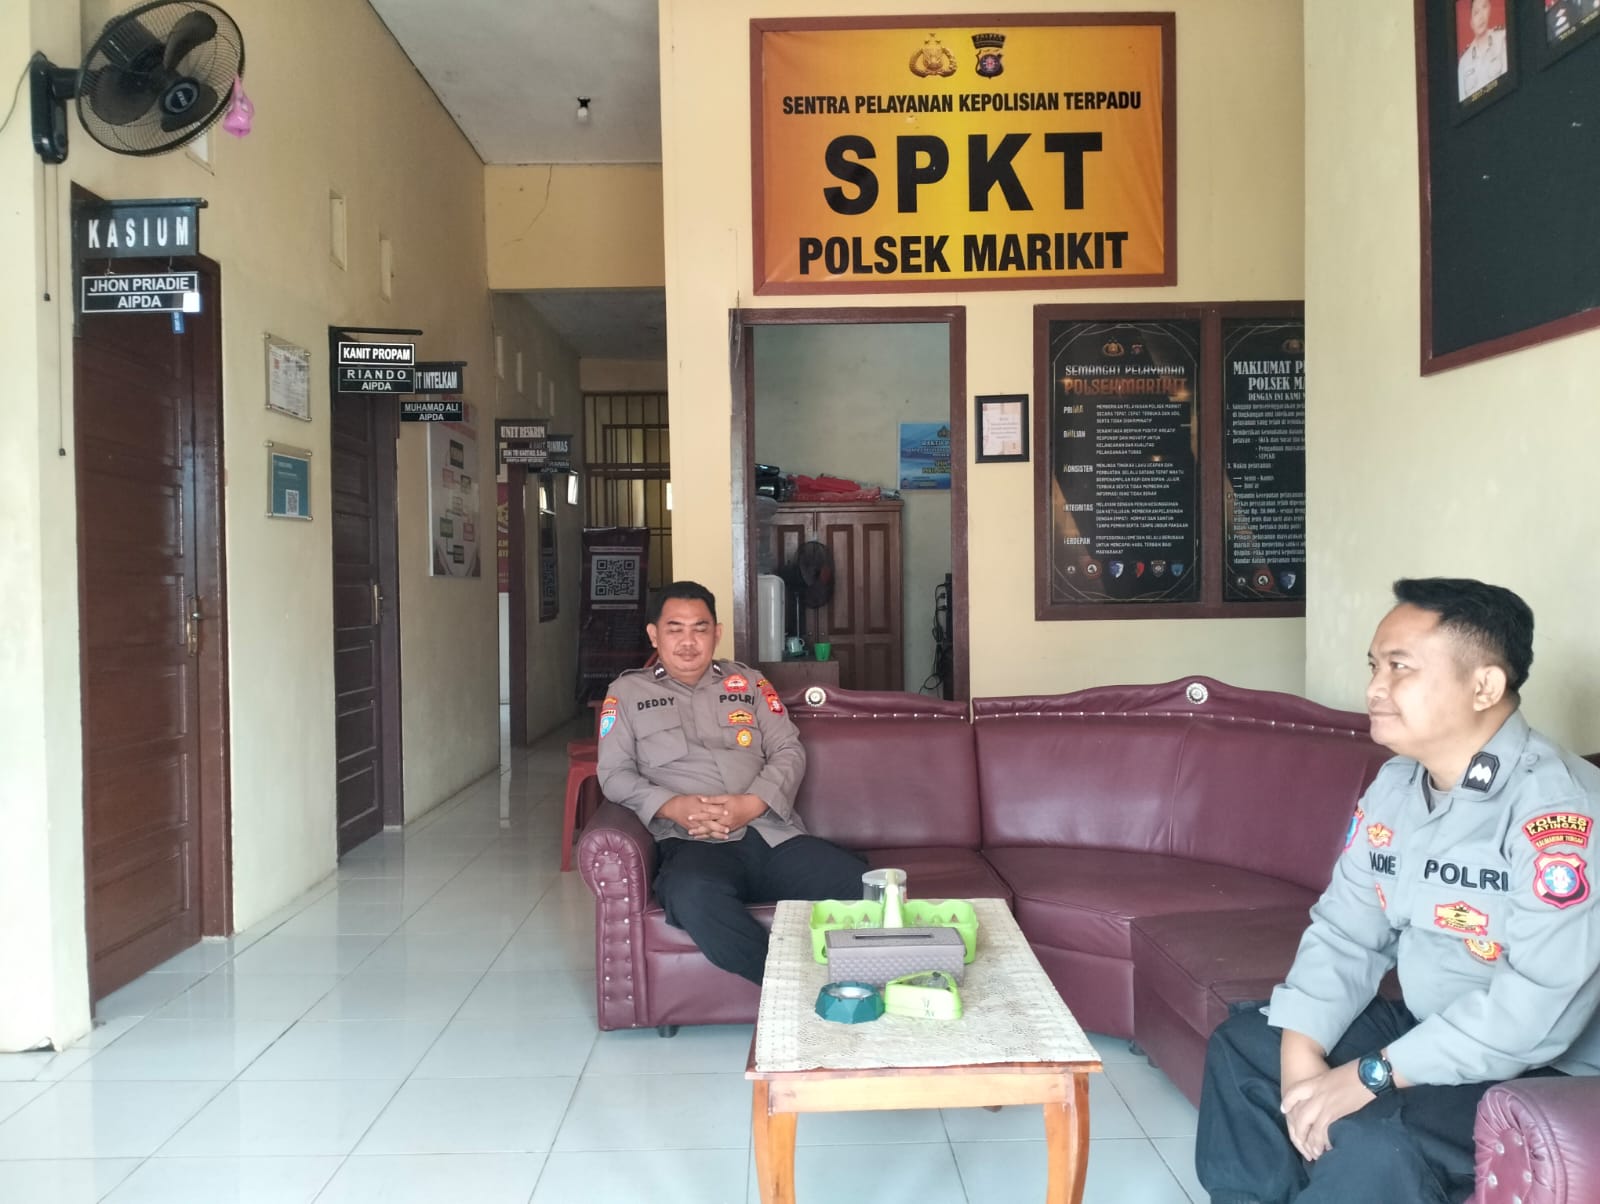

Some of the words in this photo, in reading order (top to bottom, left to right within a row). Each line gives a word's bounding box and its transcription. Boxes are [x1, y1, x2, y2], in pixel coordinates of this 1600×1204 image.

[783, 96, 850, 114] SENTRA
[855, 94, 953, 114] PELAYANAN
[958, 93, 1058, 112] KEPOLISIAN
[1064, 92, 1142, 110] TERPADU
[823, 132, 1103, 215] SPKT
[88, 216, 189, 248] KASIUM
[799, 235, 951, 275] POLSEK
[963, 231, 1129, 273] MARIKIT
[90, 279, 129, 292] JHON
[132, 277, 190, 291] PRIADIE
[118, 296, 162, 308] AIPDA
[343, 348, 371, 359] KANIT
[372, 348, 410, 360] PROPAM
[1065, 365, 1120, 376] SEMANGAT
[1124, 364, 1185, 376] PELAYANAN
[1233, 361, 1292, 375] MAKLUMAT
[1295, 360, 1305, 374] P
[347, 370, 406, 380] RIANDO
[423, 371, 458, 389] INTELKAM
[361, 382, 392, 390] AIPDA
[1248, 376, 1290, 390] POLSEK
[1294, 376, 1305, 390] M
[1248, 392, 1272, 400] DENGAN
[1274, 392, 1284, 400] INI
[1285, 392, 1300, 400] KAMI
[404, 404, 444, 412] MUHAMAD
[500, 426, 518, 438] UNIT
[520, 426, 544, 438] RESKRIM
[638, 697, 674, 712] DEDDY
[719, 694, 755, 706] POLRI
[1526, 816, 1587, 831] POLRES
[1529, 822, 1586, 836] KATINGAN
[1424, 859, 1509, 892] POLRI
